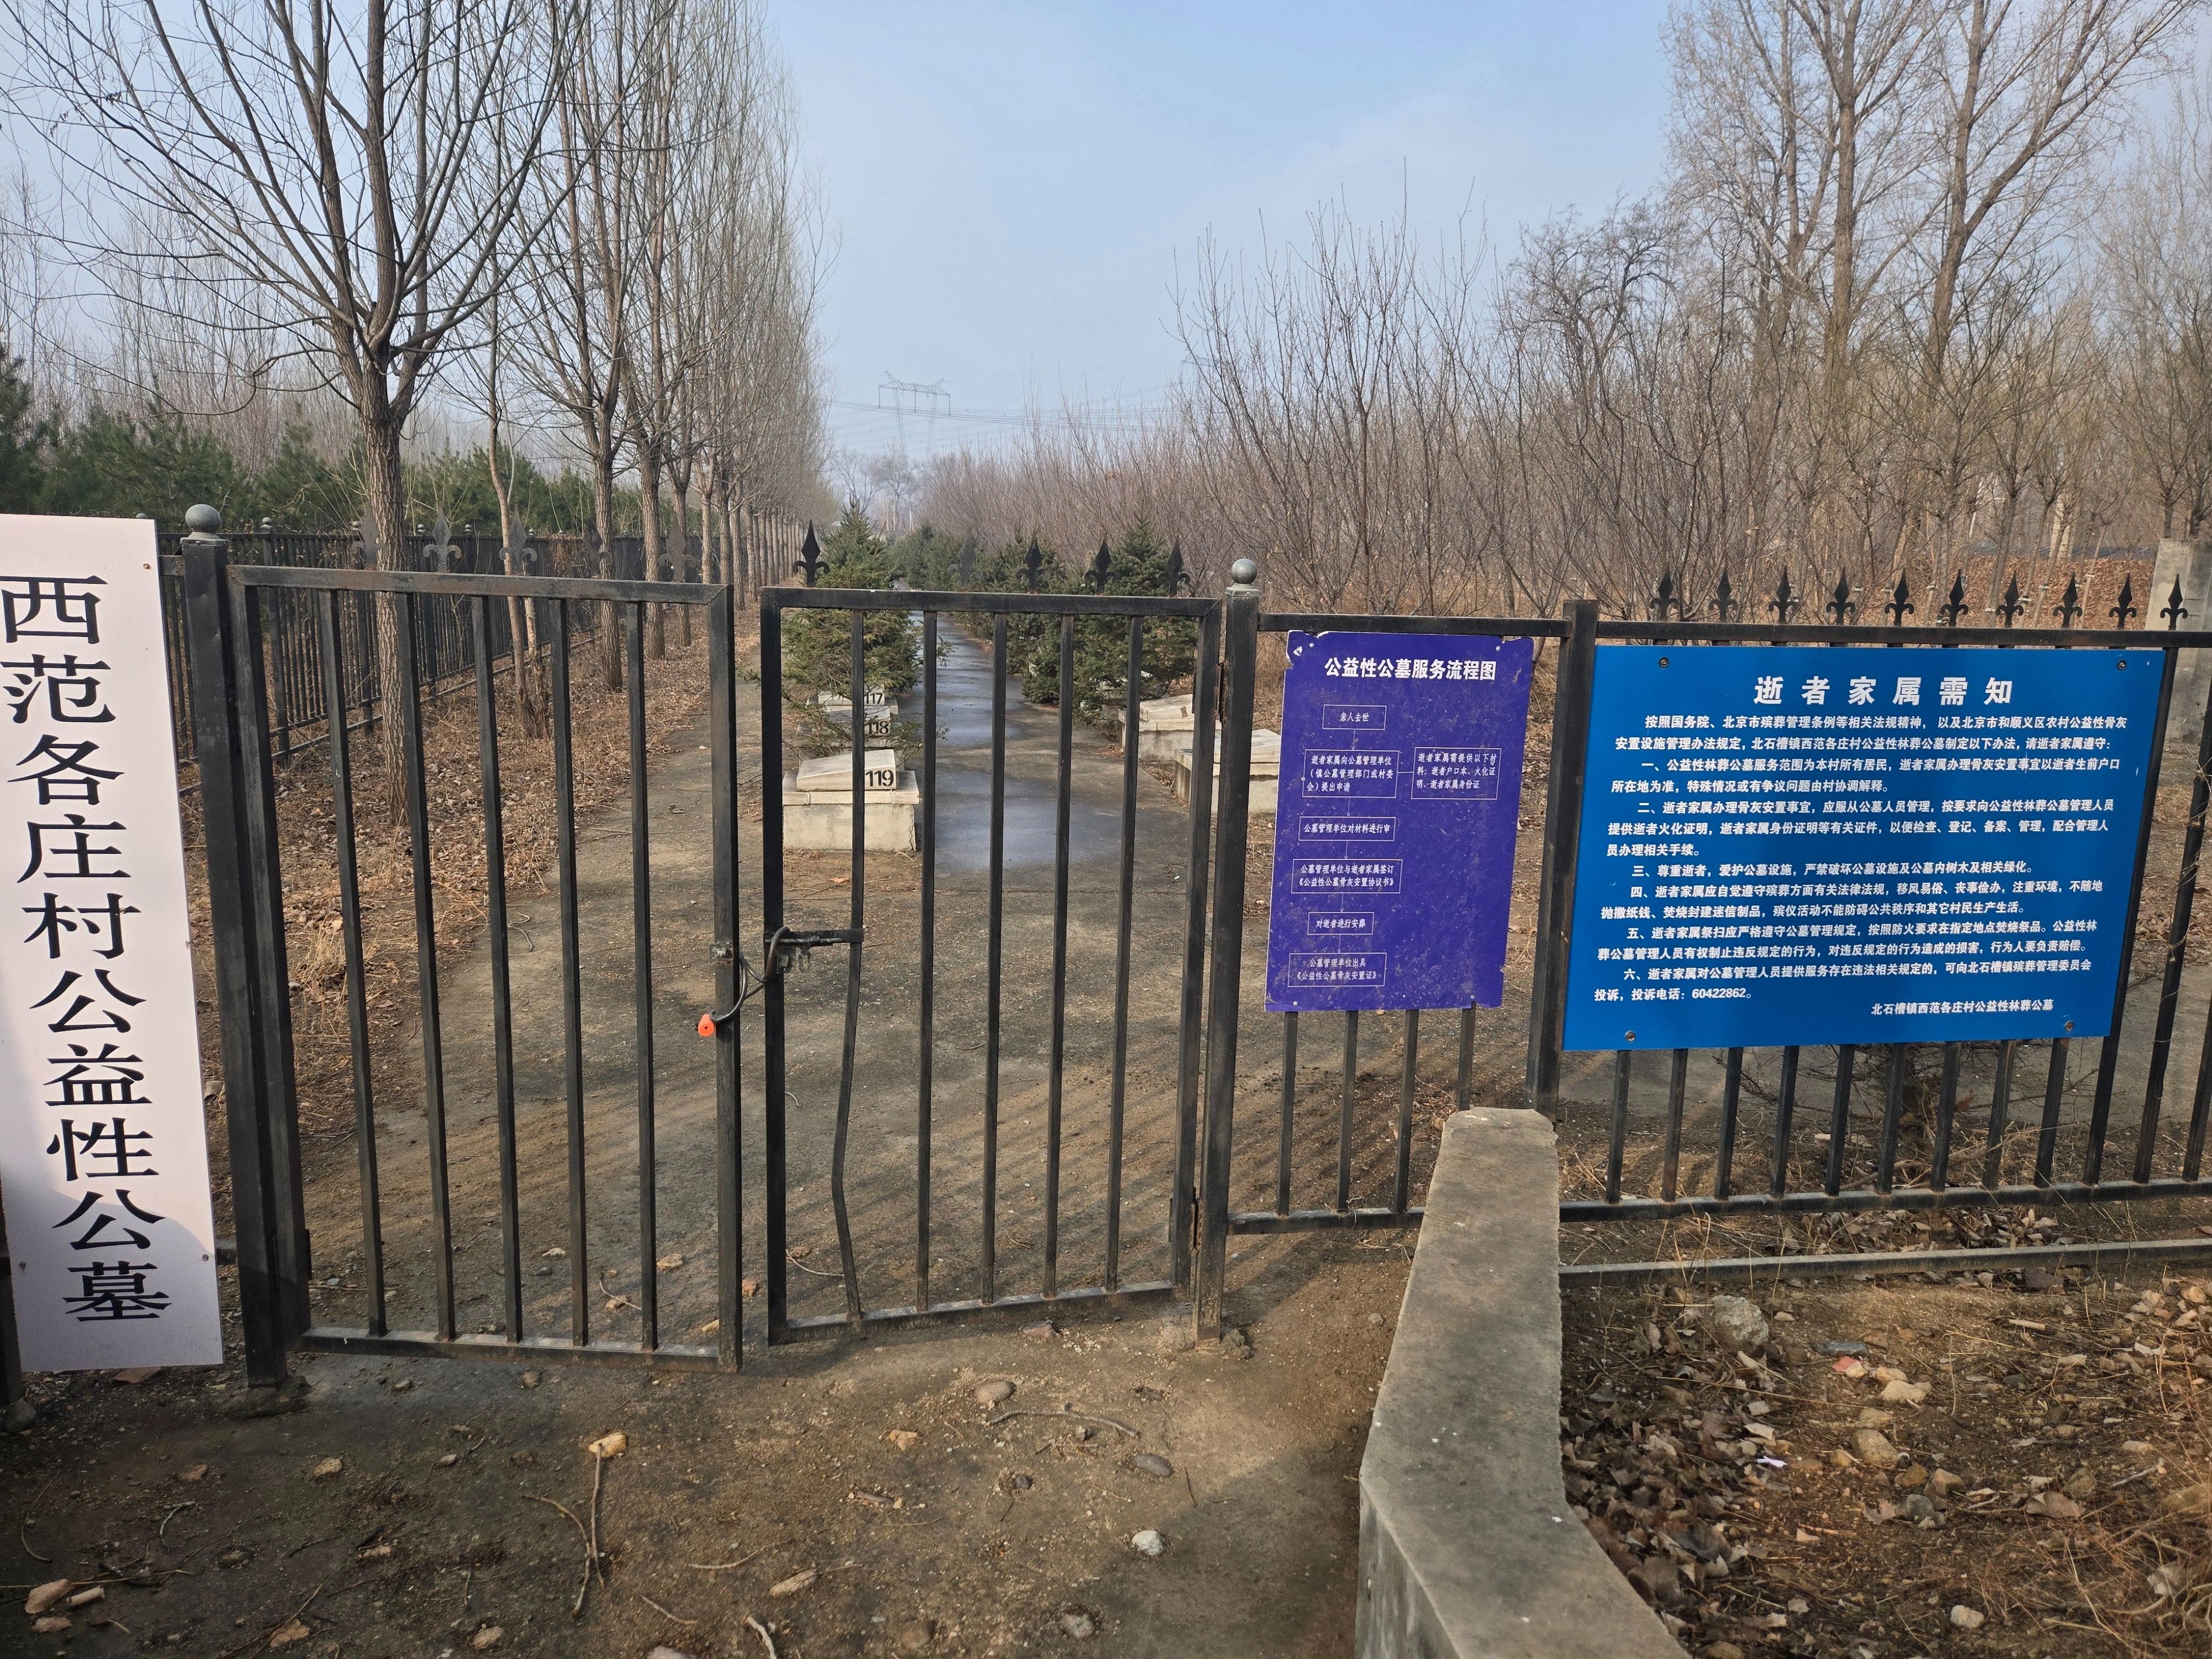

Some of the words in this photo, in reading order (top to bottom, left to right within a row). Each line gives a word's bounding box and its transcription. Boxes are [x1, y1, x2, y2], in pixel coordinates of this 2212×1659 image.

[1324, 657, 1496, 680] 公益性公墓服务流程图
[1753, 675, 2013, 706] 逝者家属需知
[1339, 712, 1369, 722] 亲人去世
[867, 721, 889, 734] 118
[1311, 754, 1392, 766] 逝者家属向公墓管理单位
[1417, 752, 1497, 764] 逝者家属需提供以下材
[865, 769, 894, 787] 119
[1303, 822, 1391, 834] 公墓管理单位对材料进行审
[1606, 843, 1700, 857] 员办理相关手续。
[1300, 864, 1395, 874] 公墓管理单位与逝者家属签订
[1299, 877, 1394, 887] 《公益性公墓骨灰安置协议书》
[1315, 918, 1366, 929] 对逝者进行安葬
[0, 575, 170, 1323] 西范各庄村公益性公墓
[1308, 957, 1366, 968] 公墓管理单位出具
[1296, 971, 1377, 981] 《公益性公墓骨灰安置证》
[1871, 998, 2054, 1016] 北石槽镇西范各庄村公益性林葬公墓
